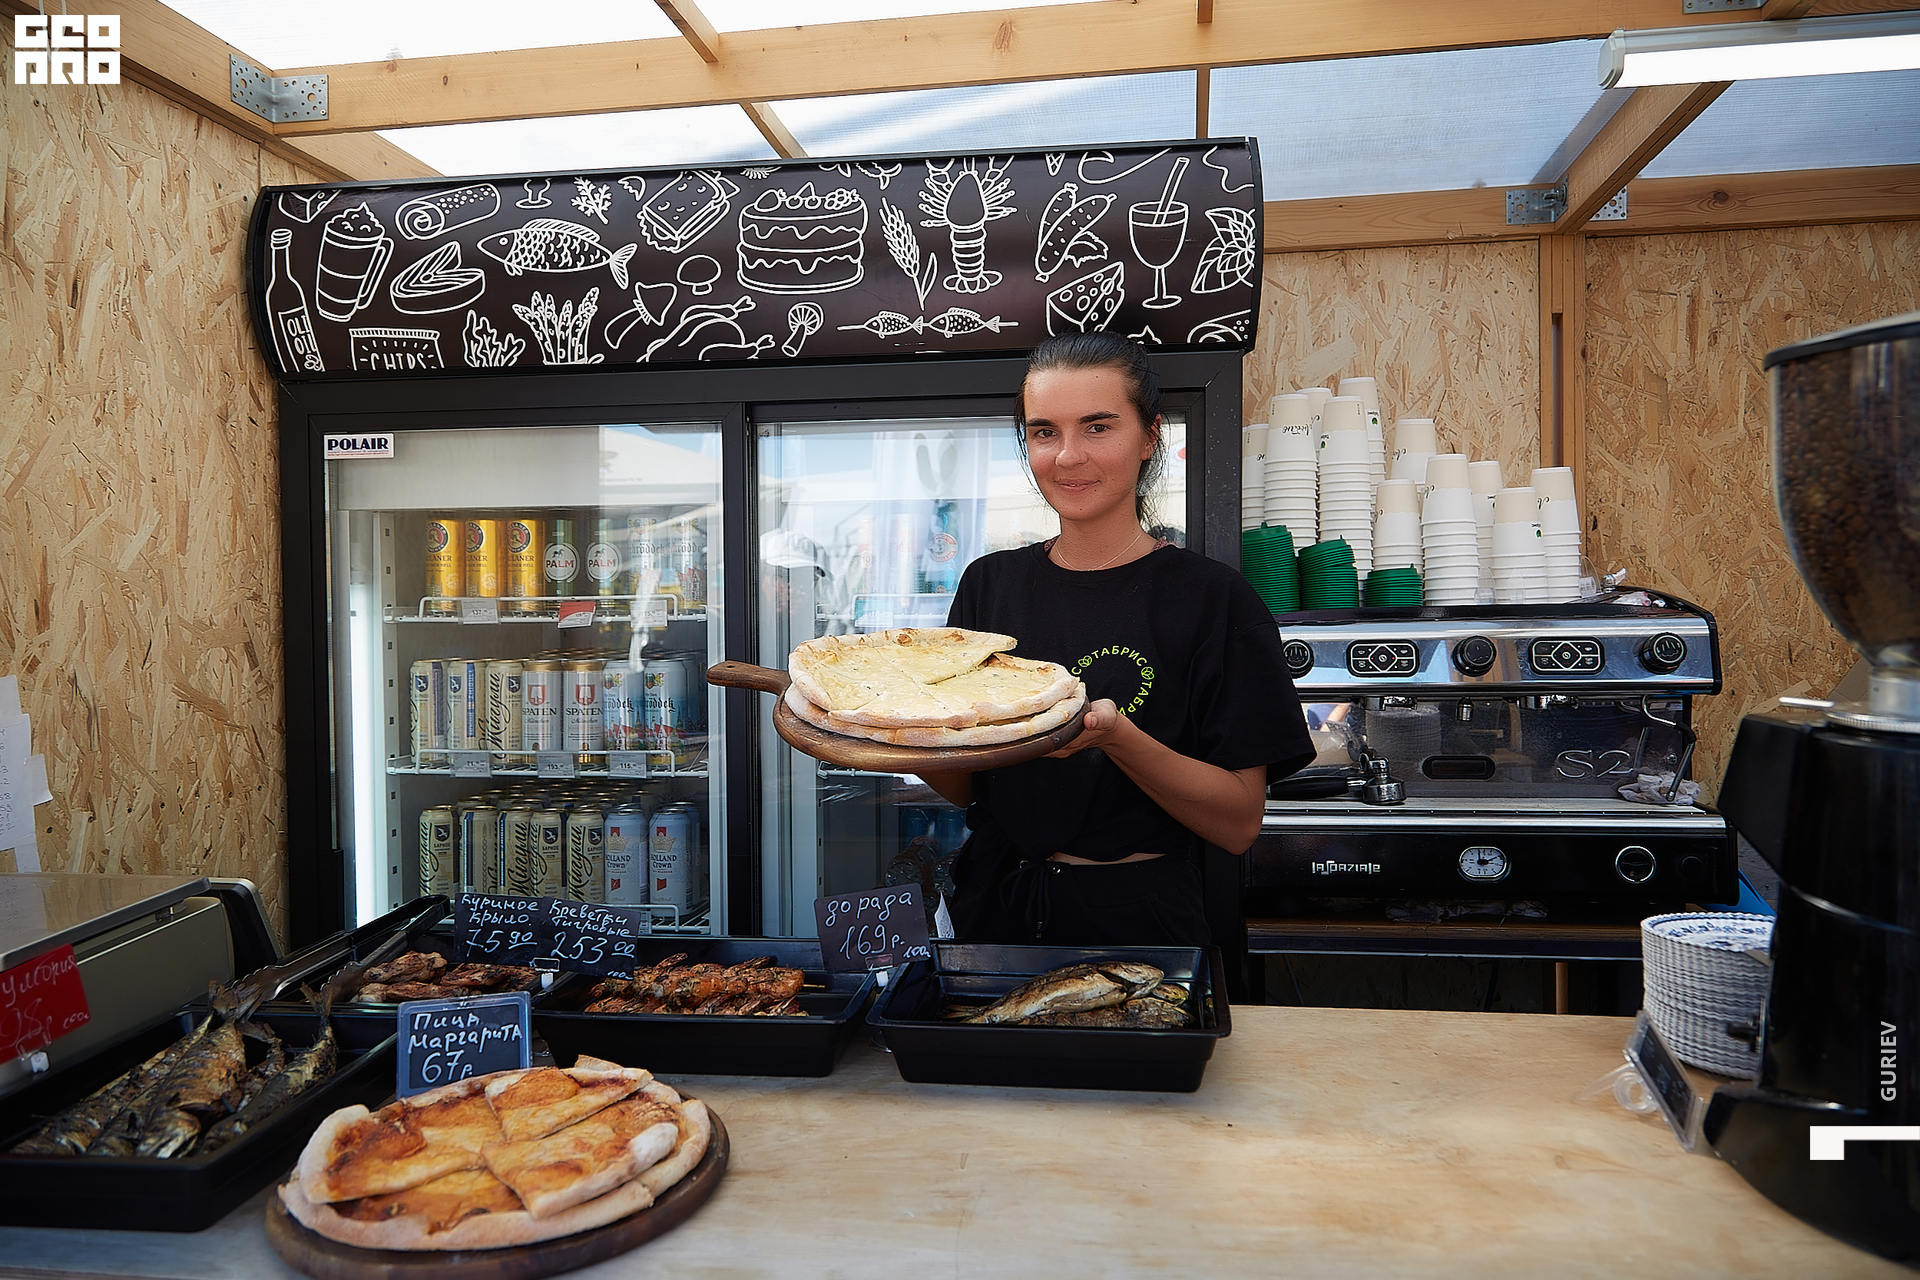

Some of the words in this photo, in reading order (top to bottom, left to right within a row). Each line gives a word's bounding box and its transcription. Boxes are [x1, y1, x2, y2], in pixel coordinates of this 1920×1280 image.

[327, 437, 389, 451] POLAIR
[546, 560, 574, 568] PALM
[589, 559, 616, 567] PALM
[1091, 645, 1148, 667] ТАБРИС
[522, 707, 557, 716] SPATEN
[565, 707, 603, 716] SPATEN
[1556, 749, 1634, 778] S2
